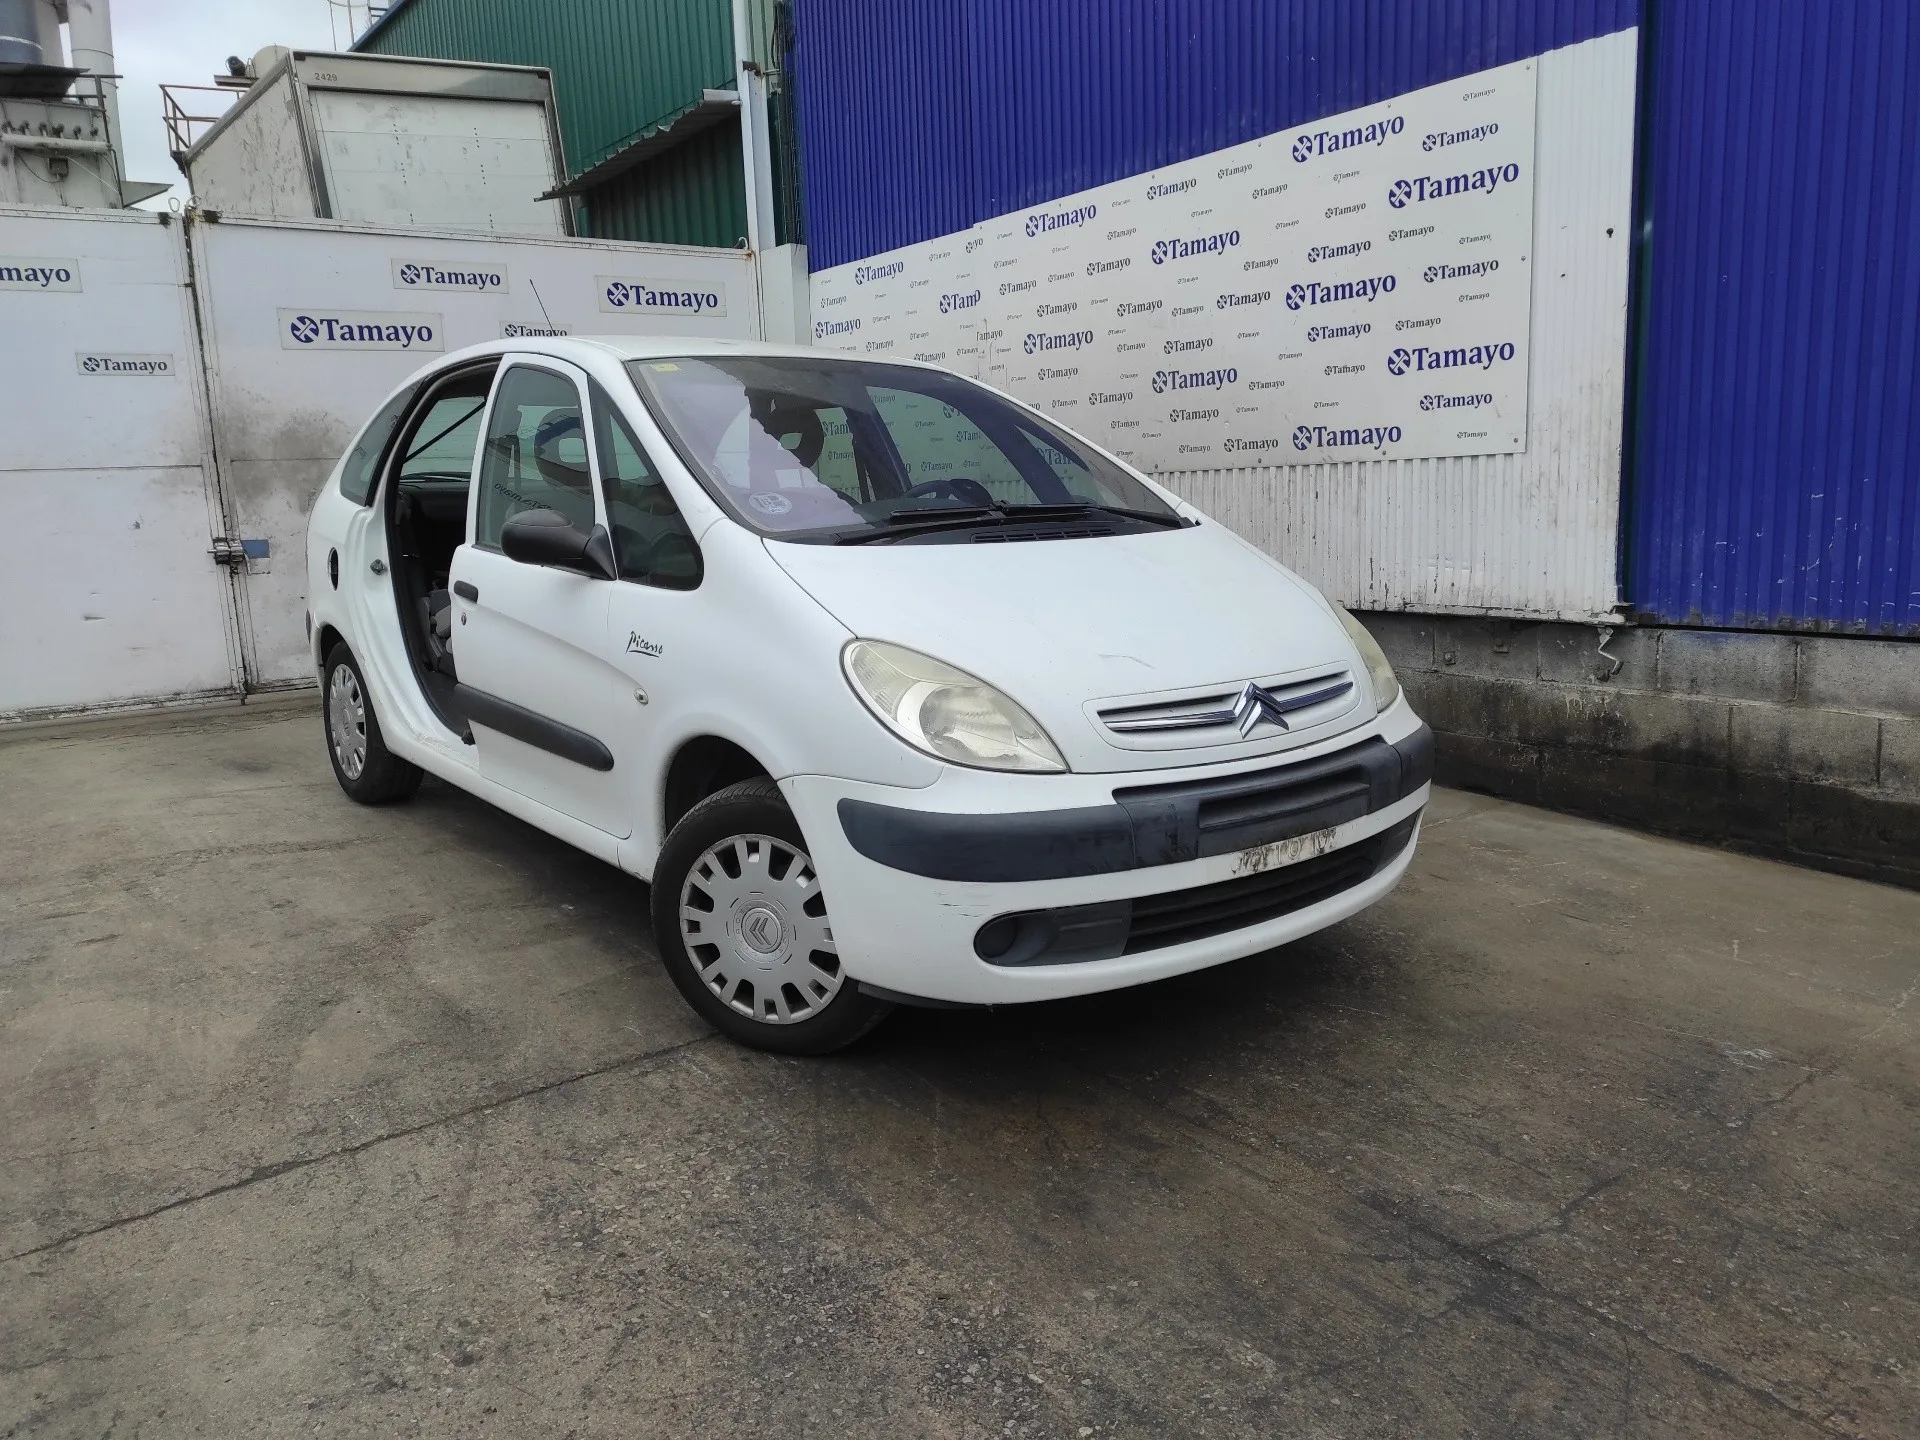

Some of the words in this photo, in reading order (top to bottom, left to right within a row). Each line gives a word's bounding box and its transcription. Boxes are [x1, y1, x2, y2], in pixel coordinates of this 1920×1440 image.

[314, 72, 338, 81] 2429
[1470, 89, 1495, 100] Tamayo
[1314, 116, 1404, 155] Tamayo
[1437, 122, 1498, 148] Tamayo
[1225, 164, 1252, 176] Tamayo
[1157, 178, 1196, 196] Tamayo
[1413, 163, 1519, 202] Tamayo
[1260, 184, 1288, 197] Tamayo
[1334, 203, 1366, 216] Tamayo
[1039, 205, 1096, 232] Tamayo
[1113, 228, 1136, 238] Tamayo
[1398, 226, 1435, 239] Tamayo
[1466, 234, 1491, 243] Tamayo
[1169, 230, 1240, 260] Tamayo
[1321, 241, 1371, 260] Tamayo
[1097, 258, 1131, 273] Tamayo
[1251, 258, 1278, 269] Tamayo
[1439, 260, 1499, 280] Tamayo
[420, 267, 500, 289] Tamayo
[865, 261, 904, 281] Tamayo
[1007, 280, 1037, 293] Tamayo
[1306, 275, 1396, 305] Tamayo
[630, 285, 718, 312] Tamayo
[1228, 291, 1270, 307] Tamayo
[1466, 293, 1490, 301] Tamayo
[1045, 301, 1077, 314] Tamayo
[1126, 300, 1162, 314] Tamayo
[1179, 306, 1203, 314] Tamayo
[517, 325, 567, 336] Tamayo
[824, 319, 861, 335] Tamayo
[1404, 317, 1441, 330] Tamayo
[320, 319, 432, 348] Tamayo
[1320, 323, 1371, 340] Tamayo
[1037, 331, 1093, 351] Tamayo
[1123, 343, 1145, 352] Tamayo
[1174, 338, 1213, 352] Tamayo
[921, 352, 945, 361] Tamayo
[1412, 343, 1514, 371] Tamayo
[100, 358, 167, 374] Tamayo
[1333, 365, 1365, 375] Tamayo
[1046, 368, 1078, 380] Tamayo
[1168, 368, 1237, 390] Tamayo
[1256, 379, 1284, 389] Tamayo
[1098, 391, 1133, 404] Tamayo
[1434, 393, 1493, 410] Tamayo
[1180, 409, 1219, 421] Tamayo
[1117, 421, 1139, 429] Tamayo
[1235, 437, 1278, 450] Tamayo
[1313, 425, 1401, 449] Tamayo
[1185, 445, 1211, 453] Tamayo
[625, 630, 663, 655] Picasso
